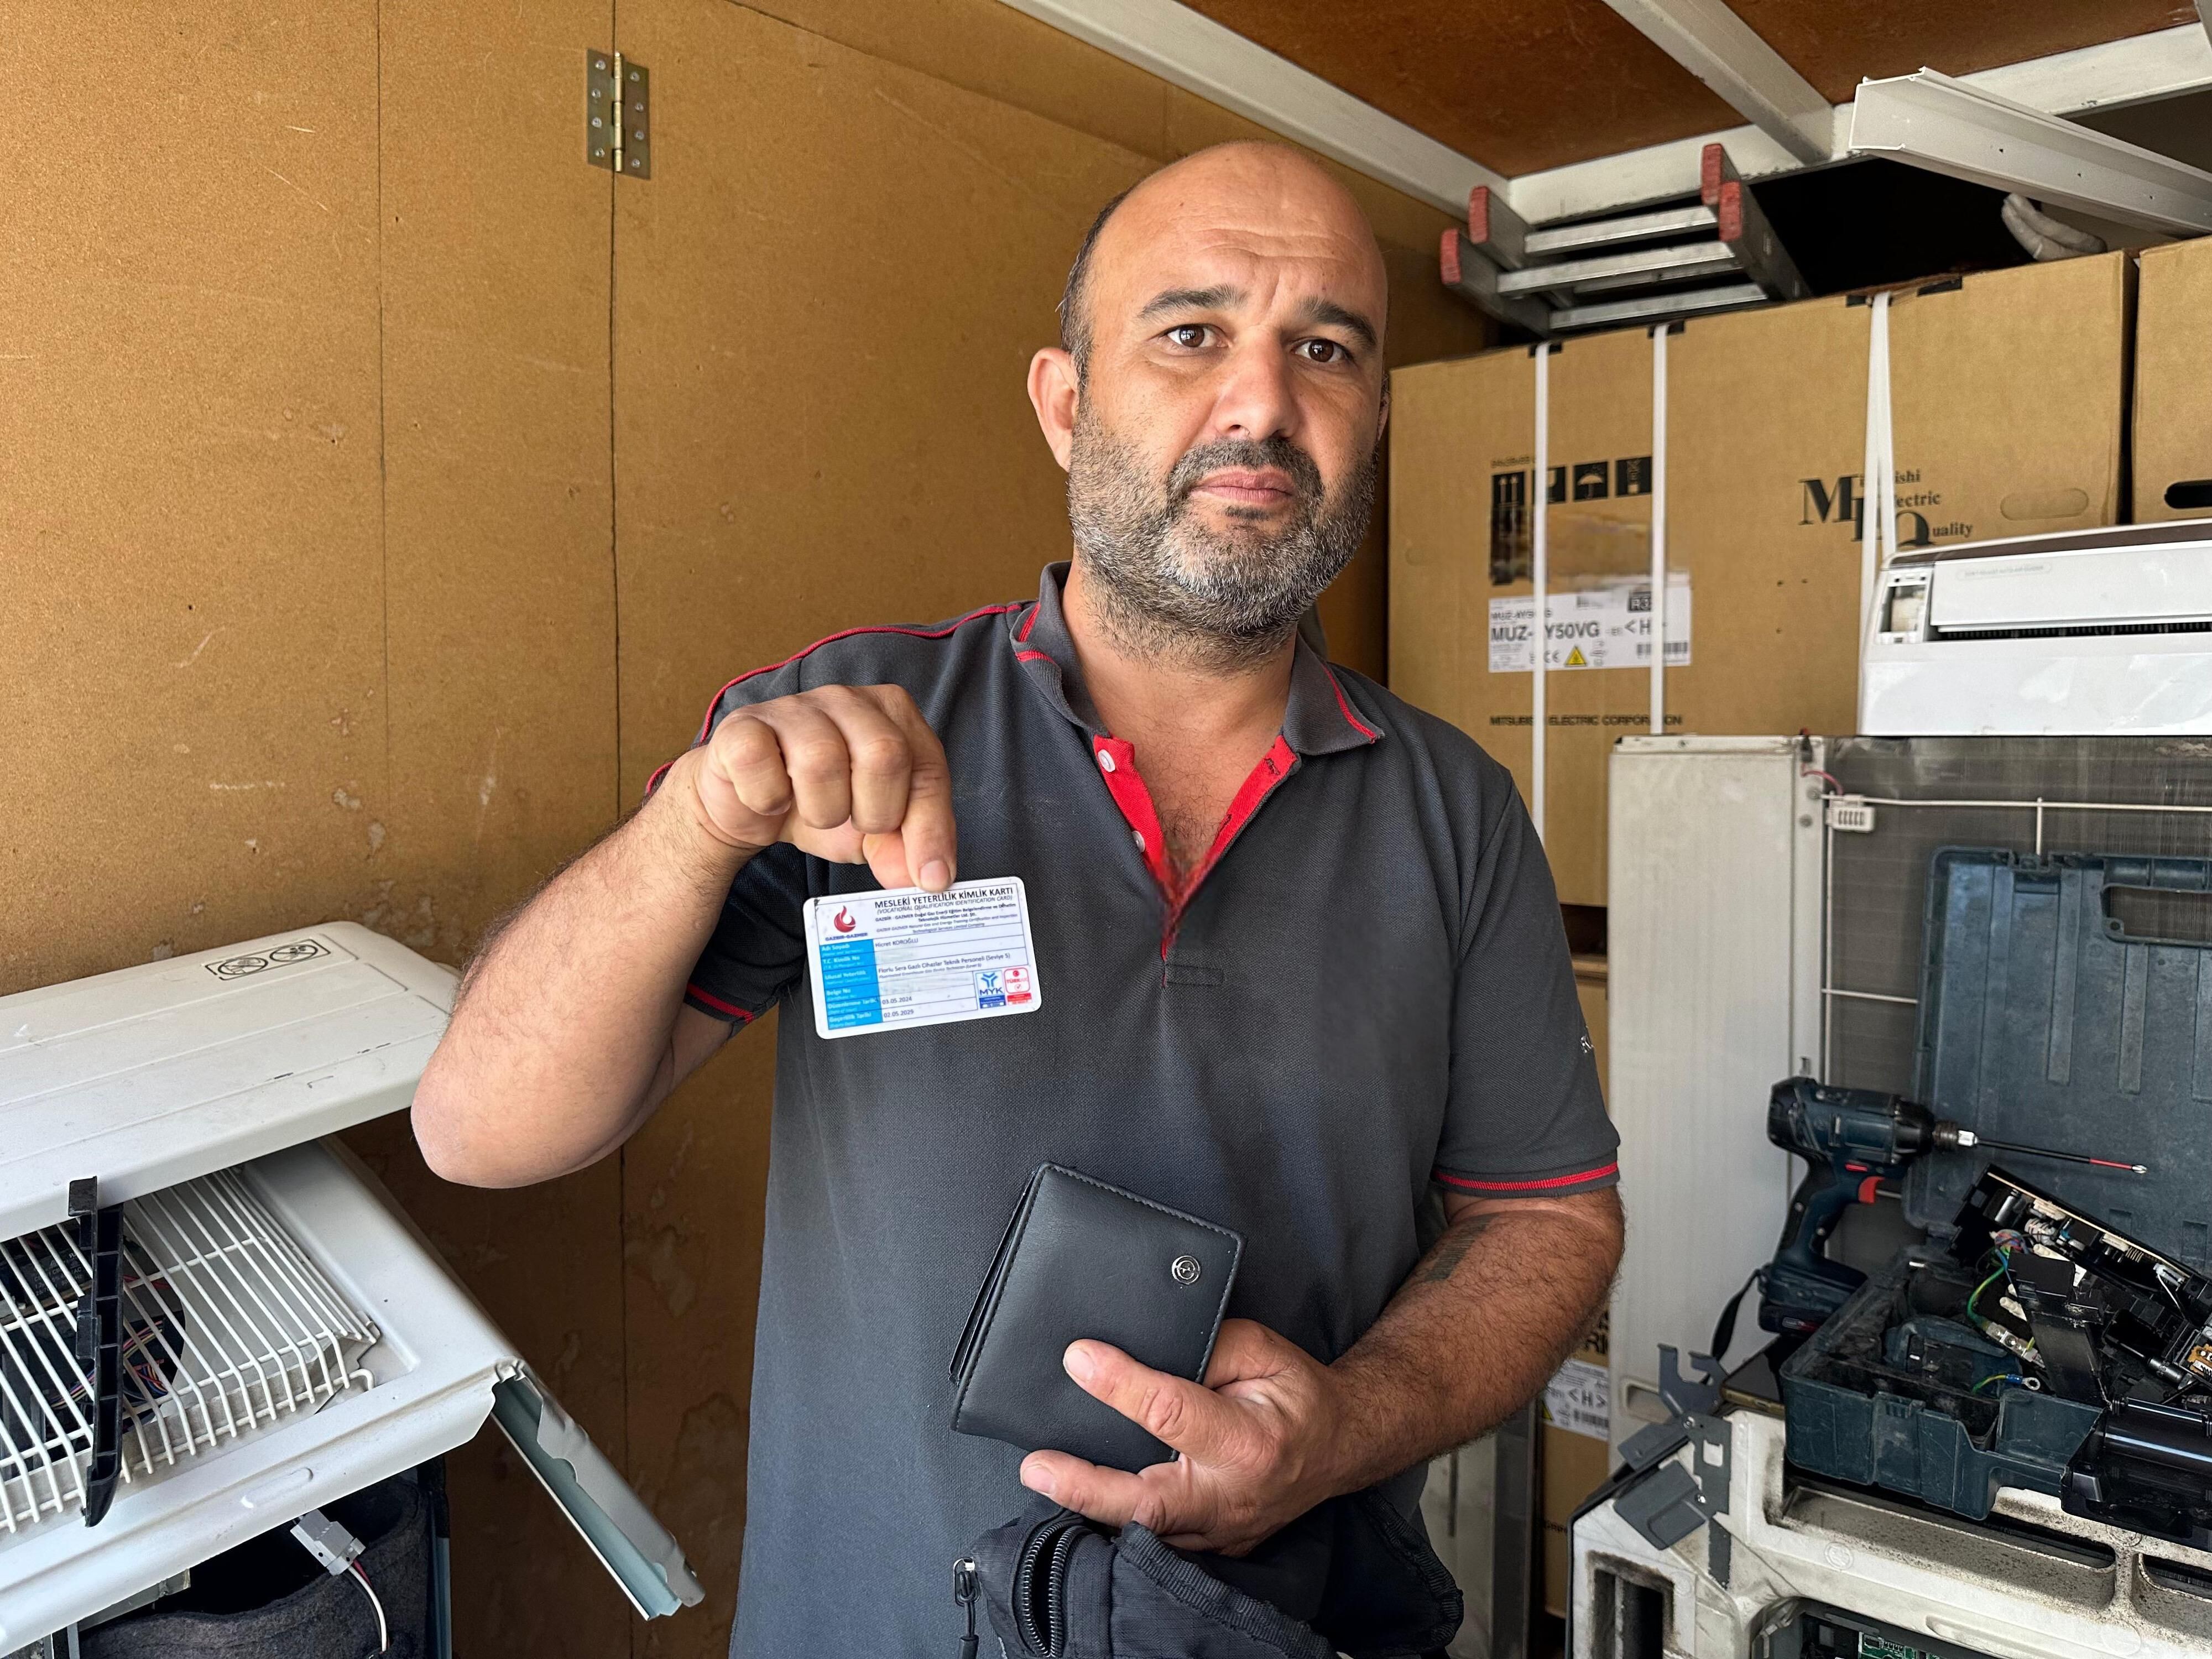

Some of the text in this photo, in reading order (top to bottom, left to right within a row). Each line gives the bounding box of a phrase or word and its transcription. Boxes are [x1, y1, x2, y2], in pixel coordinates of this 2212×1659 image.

[1631, 596, 1651, 611] R3
[1491, 621, 1599, 641] MUZ-Y50VG
[1550, 715, 1598, 726] ELECTRIC
[874, 888, 1013, 908] MESLEKİ YETERLİLİK KİMLİK KARTI
[979, 988, 1003, 996] MYK
